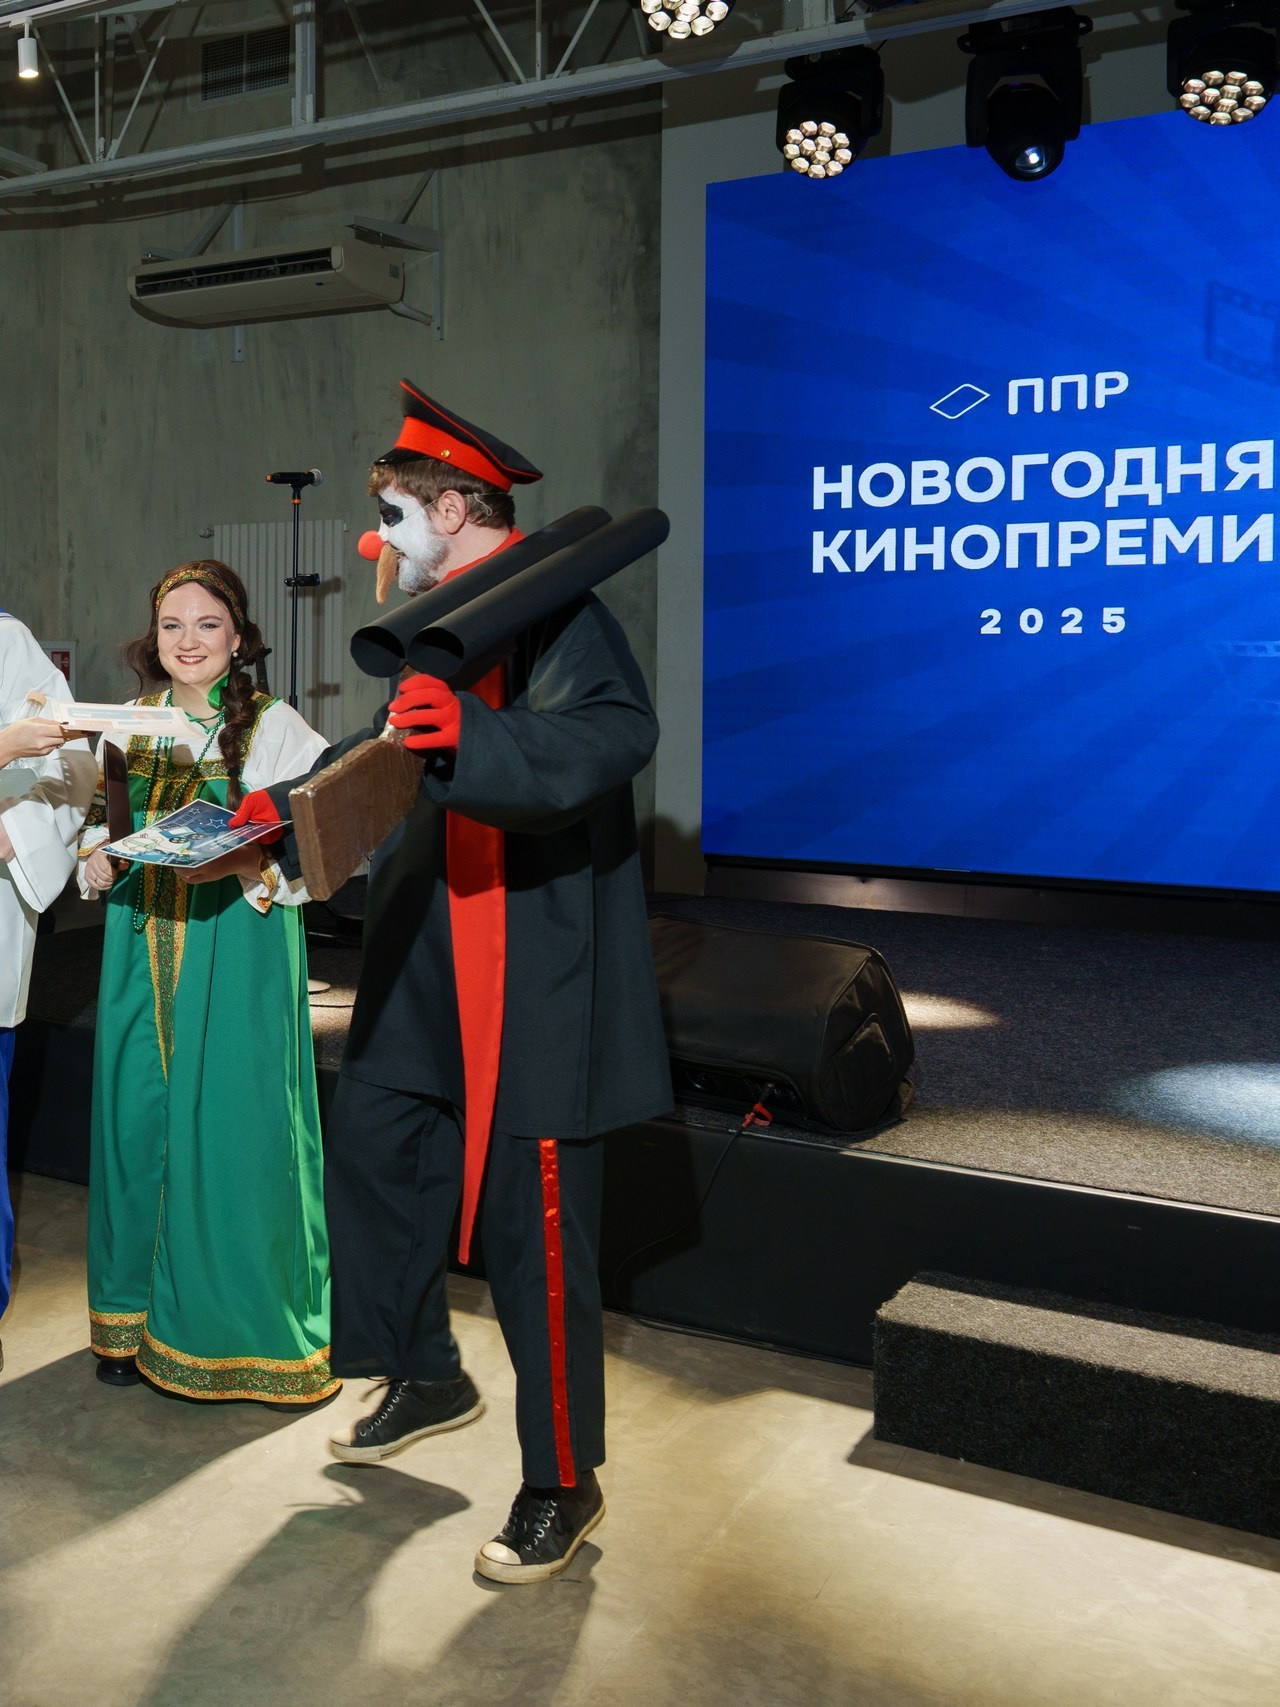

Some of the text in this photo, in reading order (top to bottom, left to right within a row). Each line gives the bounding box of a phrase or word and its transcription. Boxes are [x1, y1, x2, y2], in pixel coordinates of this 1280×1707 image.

[1008, 371, 1129, 415] ППР
[813, 439, 1275, 510] НОВОГОДНЯ
[812, 513, 1275, 573] КИНОПРЕМИ
[980, 607, 1126, 635] 2025
